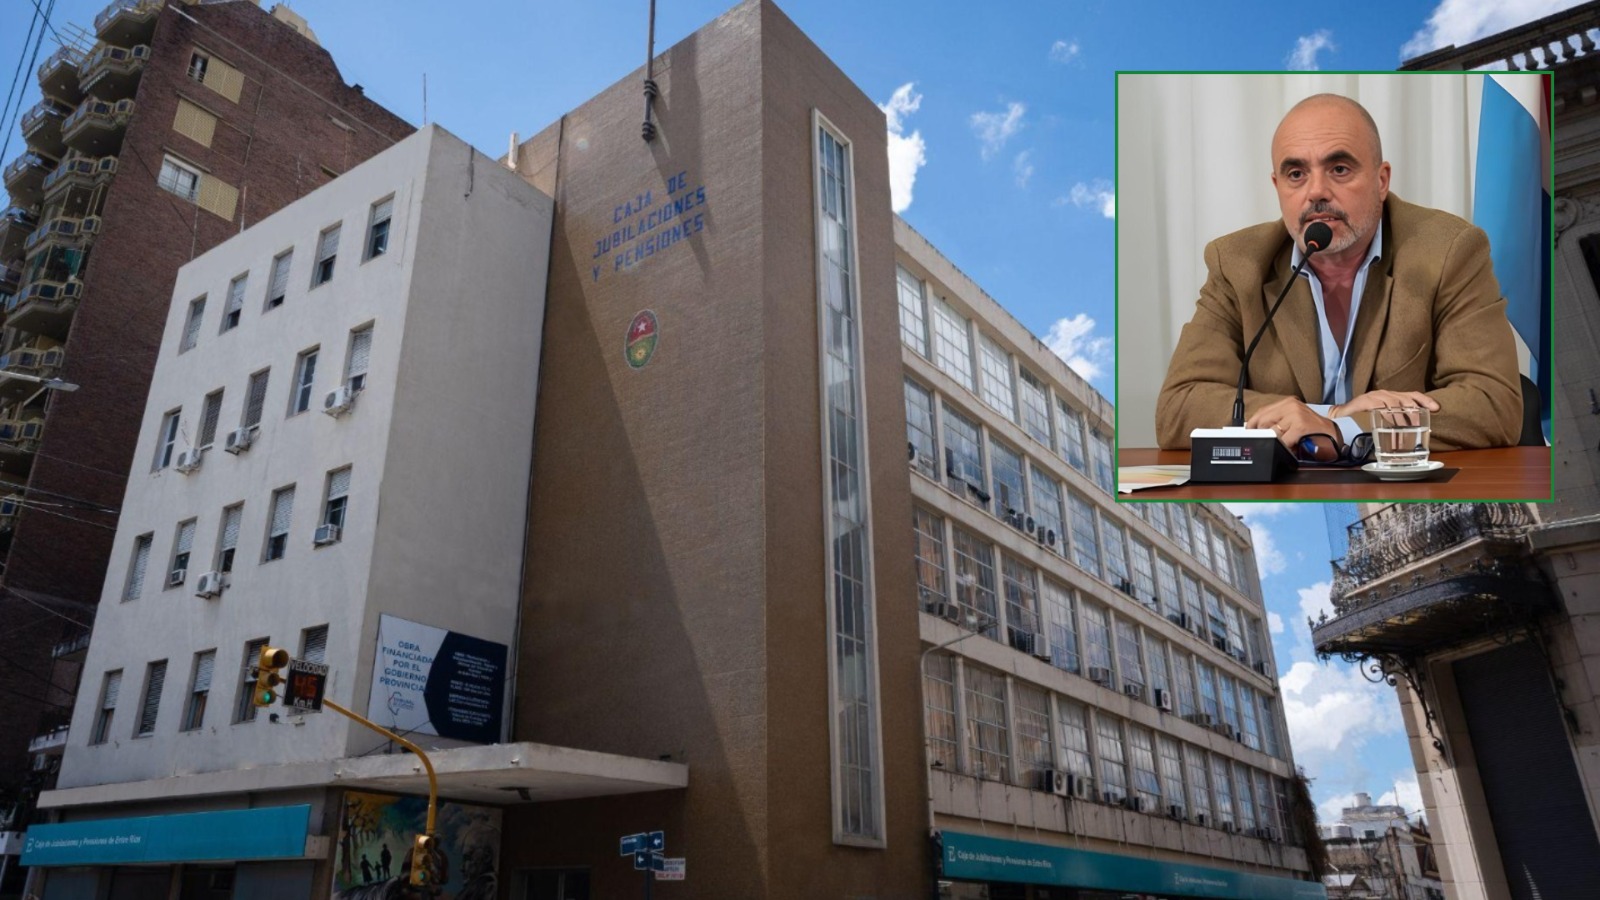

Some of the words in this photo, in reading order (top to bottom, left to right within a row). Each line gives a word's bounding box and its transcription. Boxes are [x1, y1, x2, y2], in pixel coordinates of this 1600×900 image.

[613, 189, 652, 225] CAJA
[667, 170, 687, 196] DE
[593, 185, 705, 259] JUBILACIONES
[593, 265, 600, 282] Y
[614, 212, 704, 272] PENSIONES
[398, 640, 421, 652] OBRA
[382, 646, 433, 664] FINANCIADA
[290, 660, 328, 675] VELOCIDAD
[393, 659, 410, 670] POR
[411, 663, 421, 672] EL
[384, 667, 427, 683] GOBIERNO
[379, 676, 426, 692] PROVINCIA
